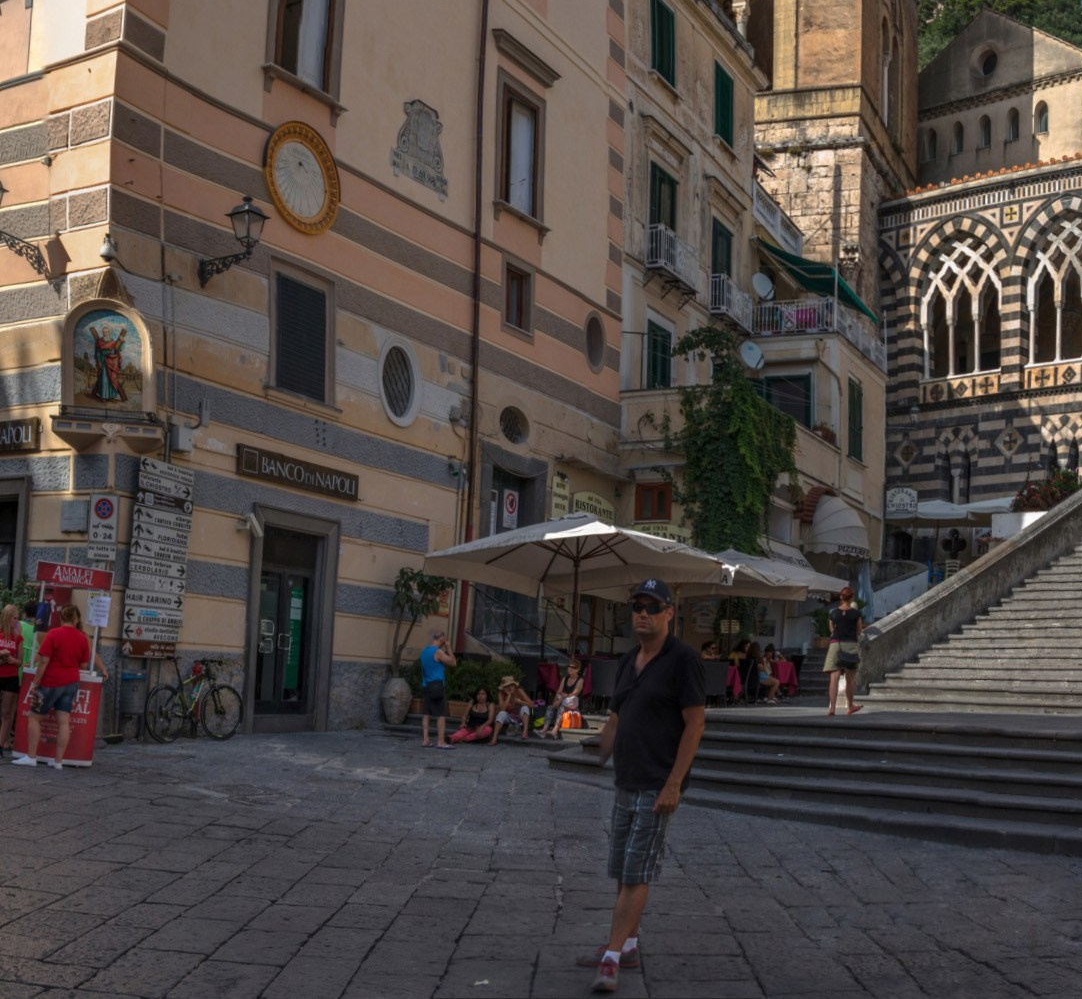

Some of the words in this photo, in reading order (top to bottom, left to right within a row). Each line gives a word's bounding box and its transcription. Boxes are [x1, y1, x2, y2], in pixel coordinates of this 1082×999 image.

[0, 426, 32, 444] APOLI
[262, 456, 304, 482] BANCO
[315, 471, 355, 495] NAPOLI
[575, 499, 613, 520] RISTORANTE
[52, 565, 93, 581] AMALFI
[60, 575, 93, 586] MUSICAL
[126, 593, 143, 601] HAIR
[146, 595, 172, 605] ZARINO
